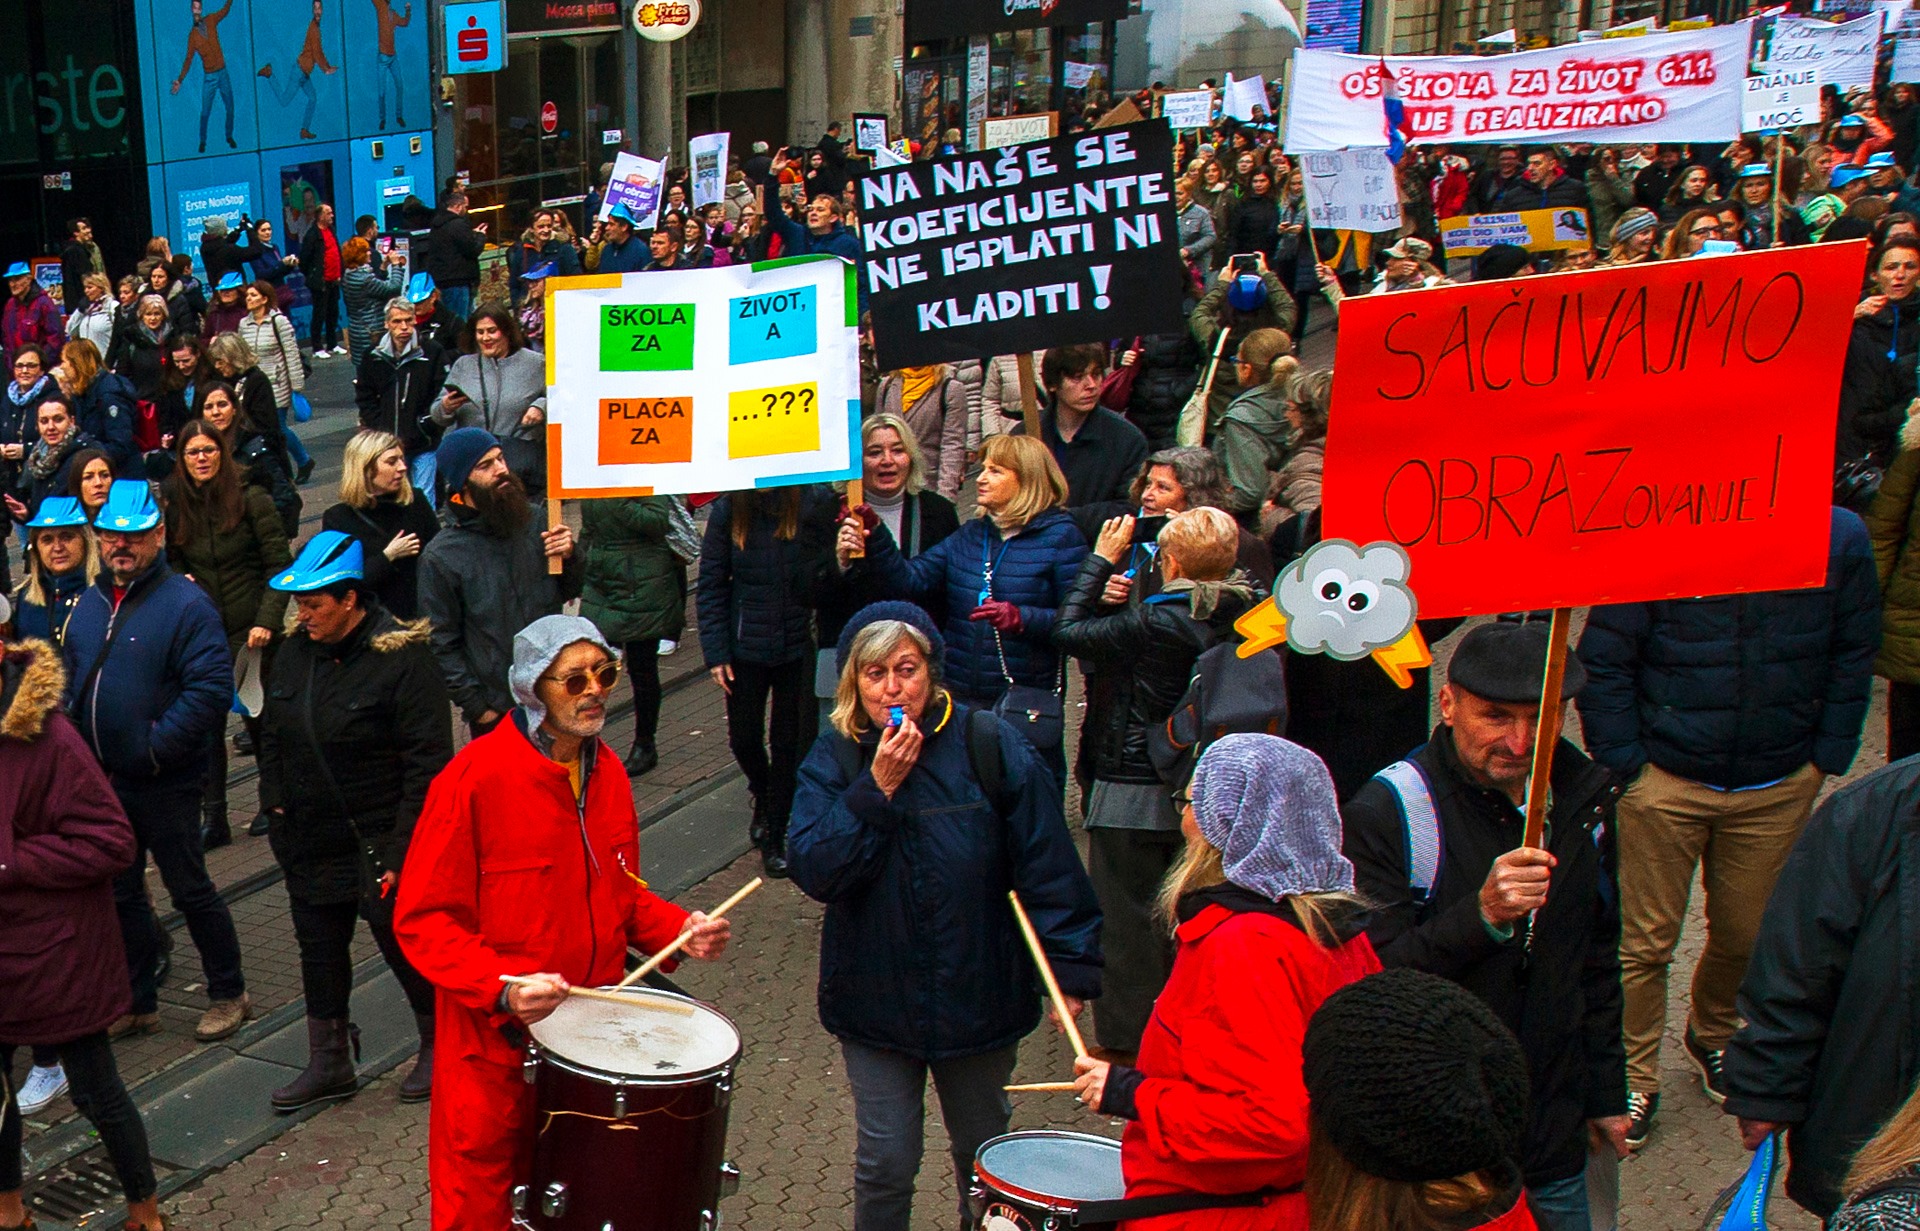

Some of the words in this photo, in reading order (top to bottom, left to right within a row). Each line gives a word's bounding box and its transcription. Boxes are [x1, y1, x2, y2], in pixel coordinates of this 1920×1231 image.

[657, 3, 688, 16] Fries
[1345, 67, 1381, 96] OŠ
[1397, 67, 1491, 98] ŠKOLA
[1512, 72, 1547, 94] ZA
[1559, 62, 1639, 91] ŽIVOT
[1776, 92, 1789, 103] JE
[1469, 99, 1663, 132] REALIZIRANO
[1759, 107, 1803, 128] MOĆ
[861, 171, 921, 210] NA
[933, 145, 1058, 196] NAŠE
[1075, 131, 1137, 169] SE
[185, 200, 207, 212] Erste
[209, 195, 244, 207] NonStop
[862, 173, 1170, 252] KOEFICIJENTE
[1500, 225, 1528, 234] VAM
[866, 254, 928, 293] NE
[941, 223, 1095, 276] ISPLATI
[1114, 213, 1162, 251] NI
[608, 305, 687, 326] ŠKOLA
[739, 291, 807, 319] ŽIVOT,
[765, 322, 782, 341] A
[1377, 271, 1804, 401] SAČUVAJMO
[631, 334, 662, 352] ZA
[630, 427, 661, 445] ZA
